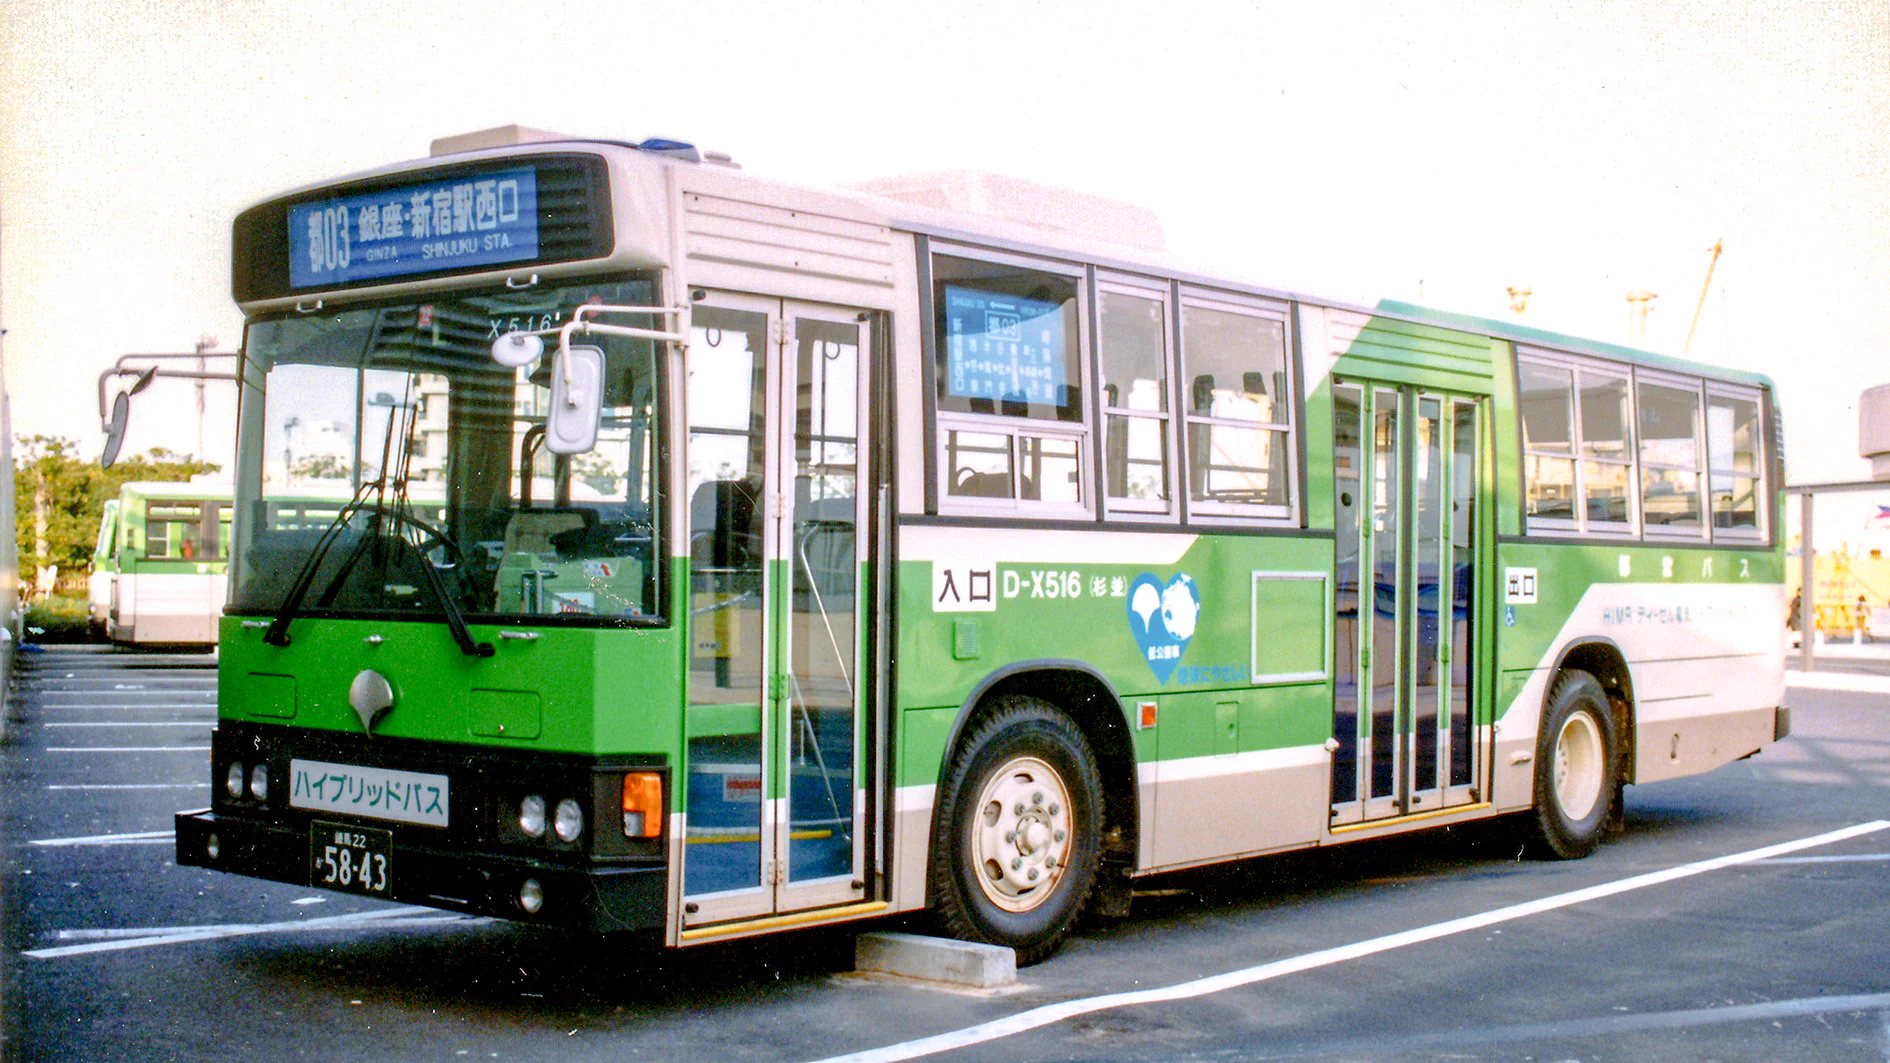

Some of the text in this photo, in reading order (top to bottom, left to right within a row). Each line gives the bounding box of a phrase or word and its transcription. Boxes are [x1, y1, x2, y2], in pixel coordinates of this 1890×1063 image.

[366, 248, 398, 262] GINZA
[422, 240, 477, 260] SHINJUKU
[939, 569, 991, 603] 入口
[1003, 570, 1081, 598] D-X516
[1508, 574, 1534, 596] 出口
[294, 770, 443, 816] ハイブリッドバス
[352, 834, 366, 848] 22
